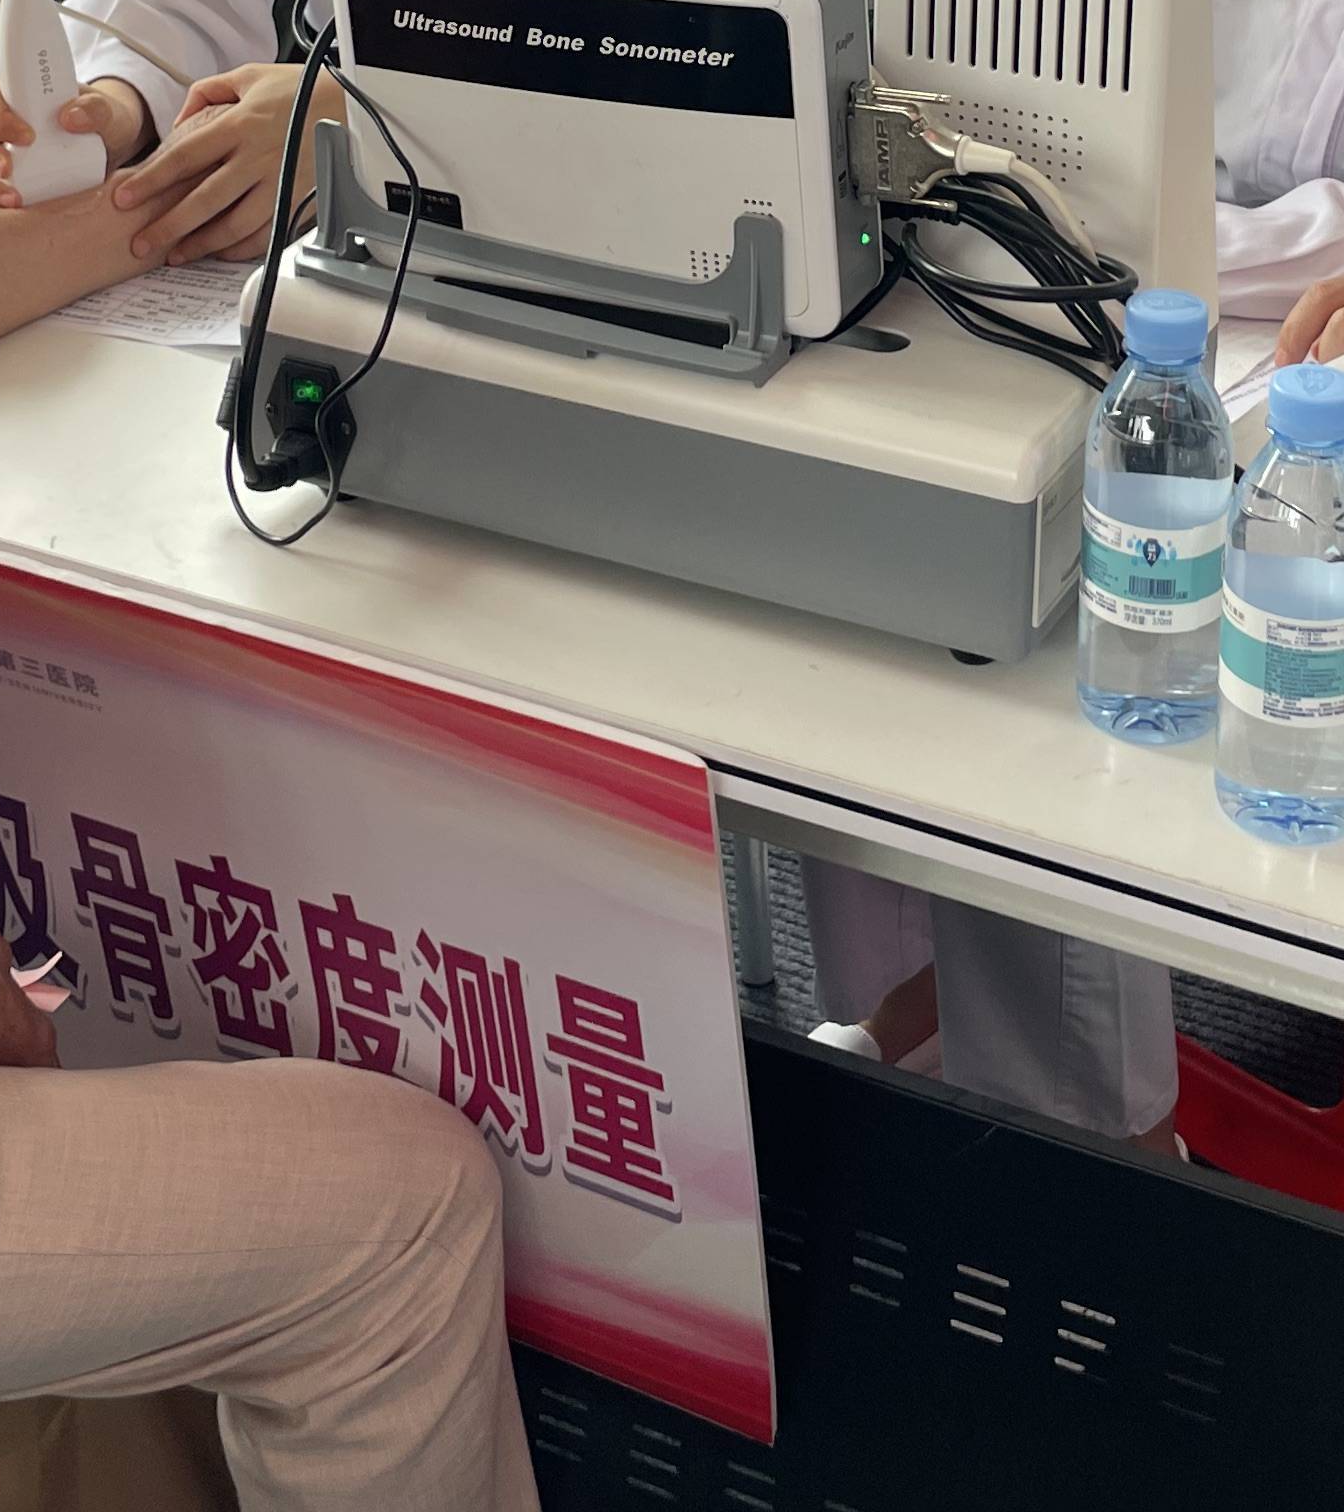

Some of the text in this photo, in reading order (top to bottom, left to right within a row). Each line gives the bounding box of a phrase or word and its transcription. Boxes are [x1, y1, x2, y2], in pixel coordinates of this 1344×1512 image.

[393, 9, 735, 68] Ultrasound Bone Sonometer
[875, 118, 892, 190] AMP
